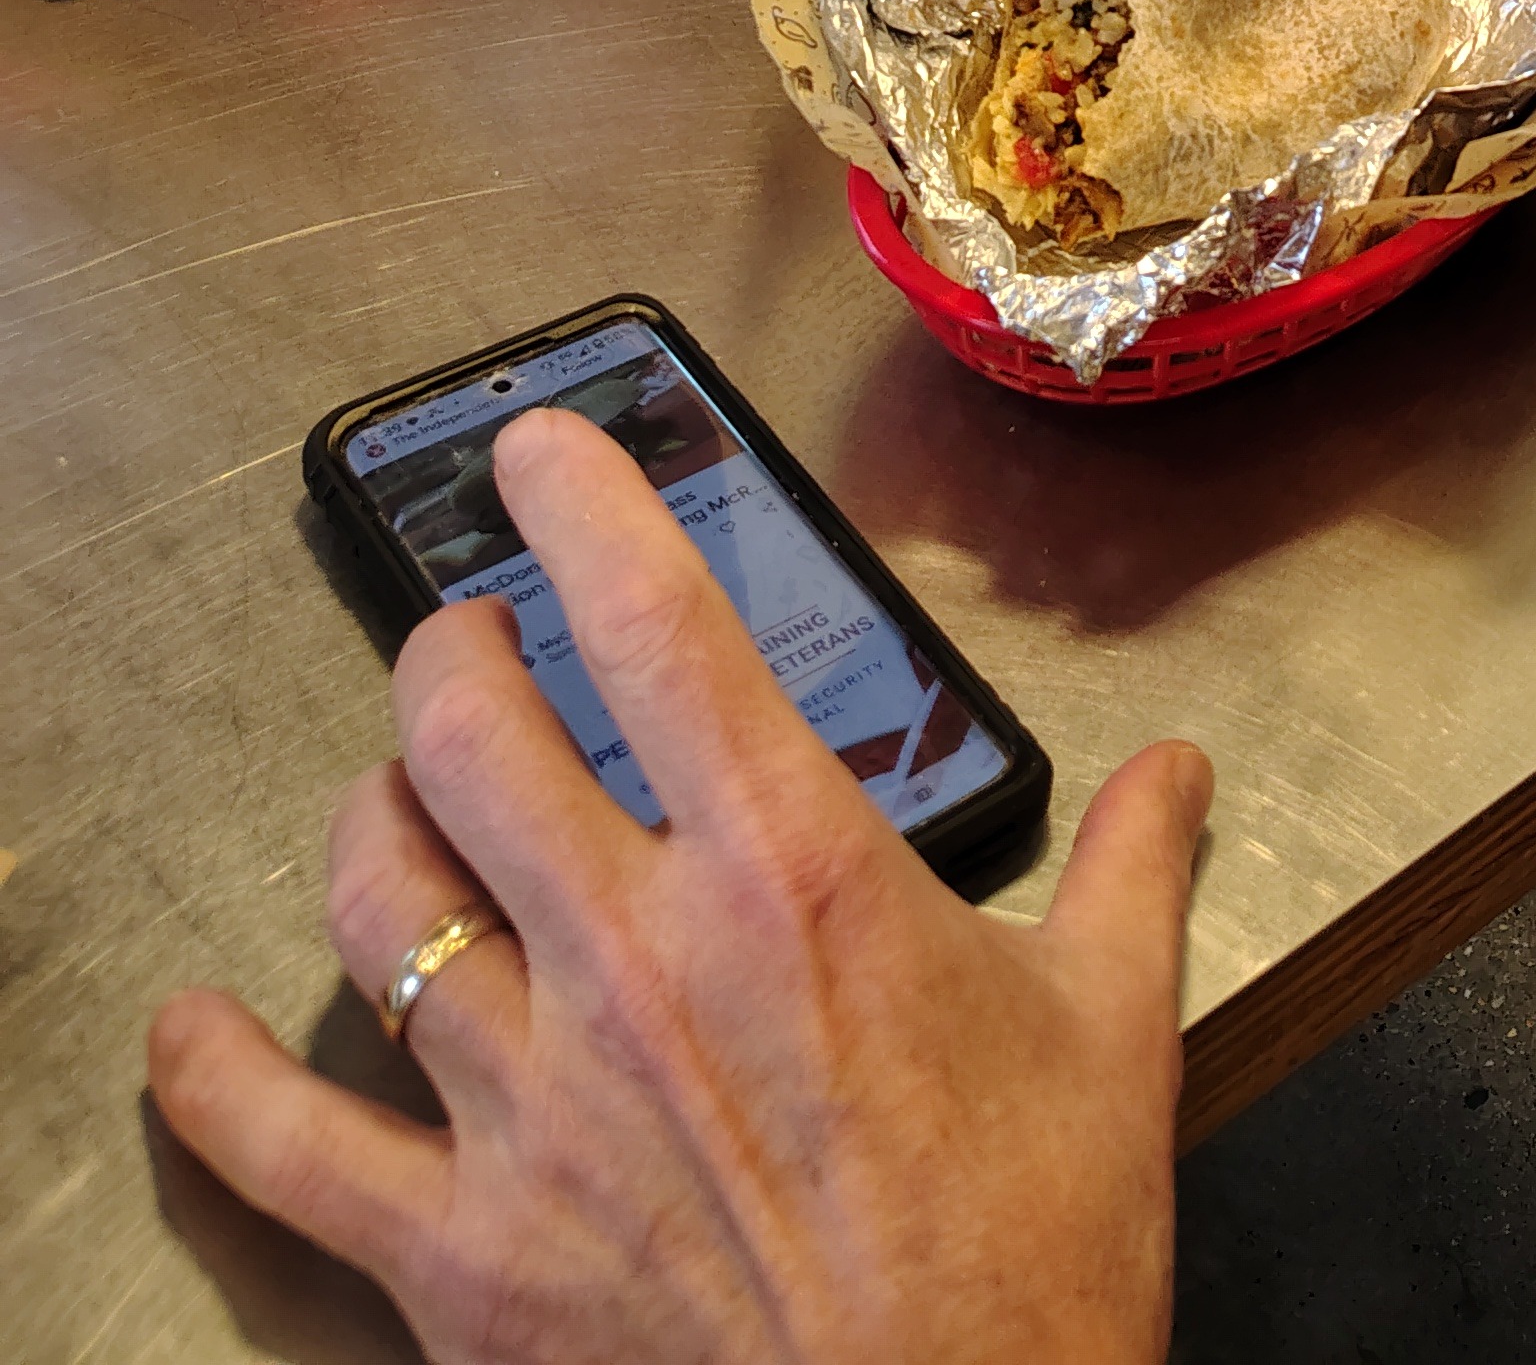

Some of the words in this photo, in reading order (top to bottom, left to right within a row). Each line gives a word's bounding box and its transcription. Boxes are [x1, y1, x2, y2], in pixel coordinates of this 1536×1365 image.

[392, 431, 418, 447] The
[666, 491, 697, 511] ass
[510, 584, 546, 605] ion
[679, 509, 708, 526] ng
[770, 616, 875, 677] ETERANS
[800, 659, 883, 710] SECURITY
[807, 704, 845, 724] NAL
